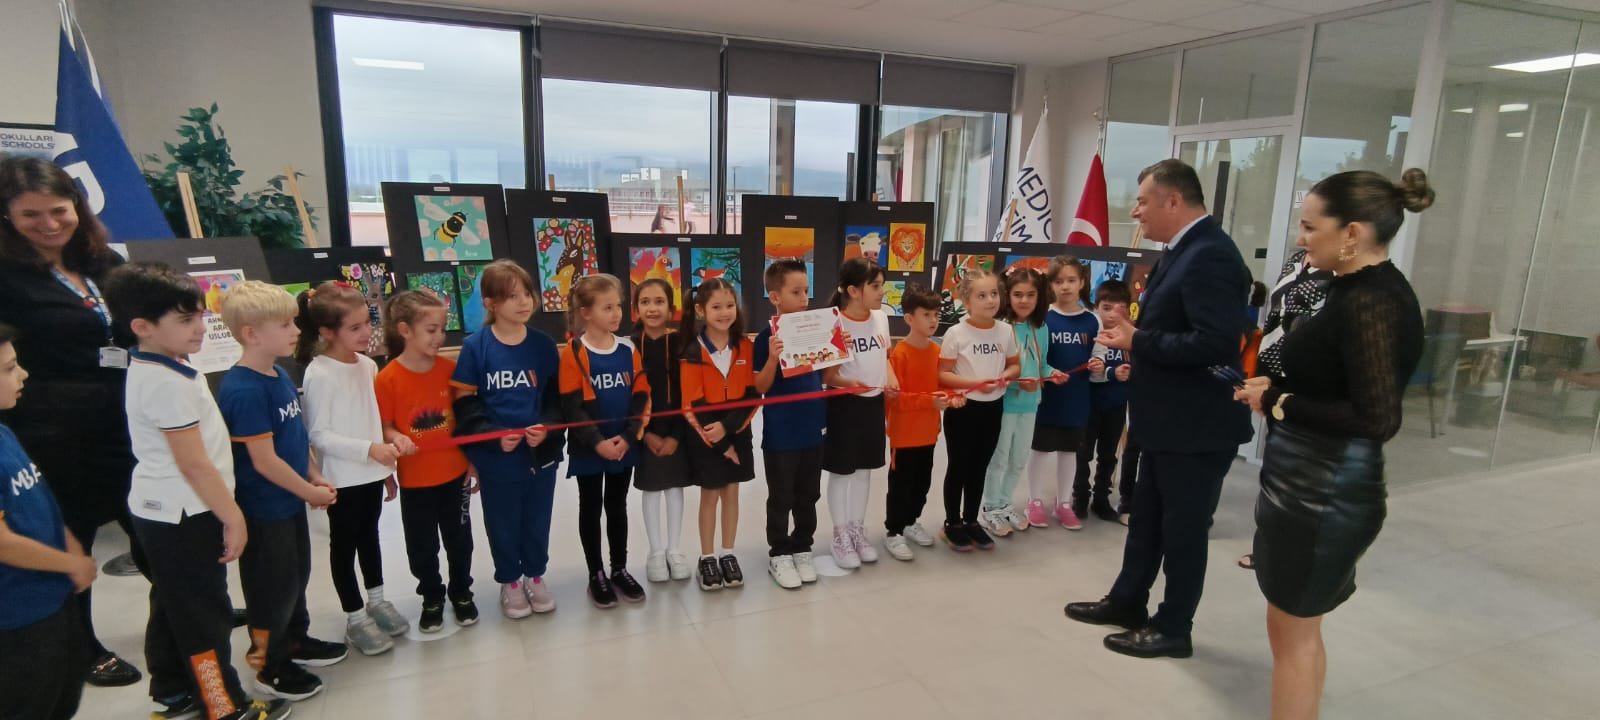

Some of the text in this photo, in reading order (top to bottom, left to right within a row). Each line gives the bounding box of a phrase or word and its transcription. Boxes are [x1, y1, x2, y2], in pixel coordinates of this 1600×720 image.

[0, 133, 54, 142] OKULLARI
[1, 140, 56, 150] SCHOOLS
[1051, 331, 1082, 345] MBA
[973, 343, 999, 354] MBA
[486, 370, 532, 390] MBA
[590, 372, 626, 389] MBA
[278, 399, 302, 422] MBA
